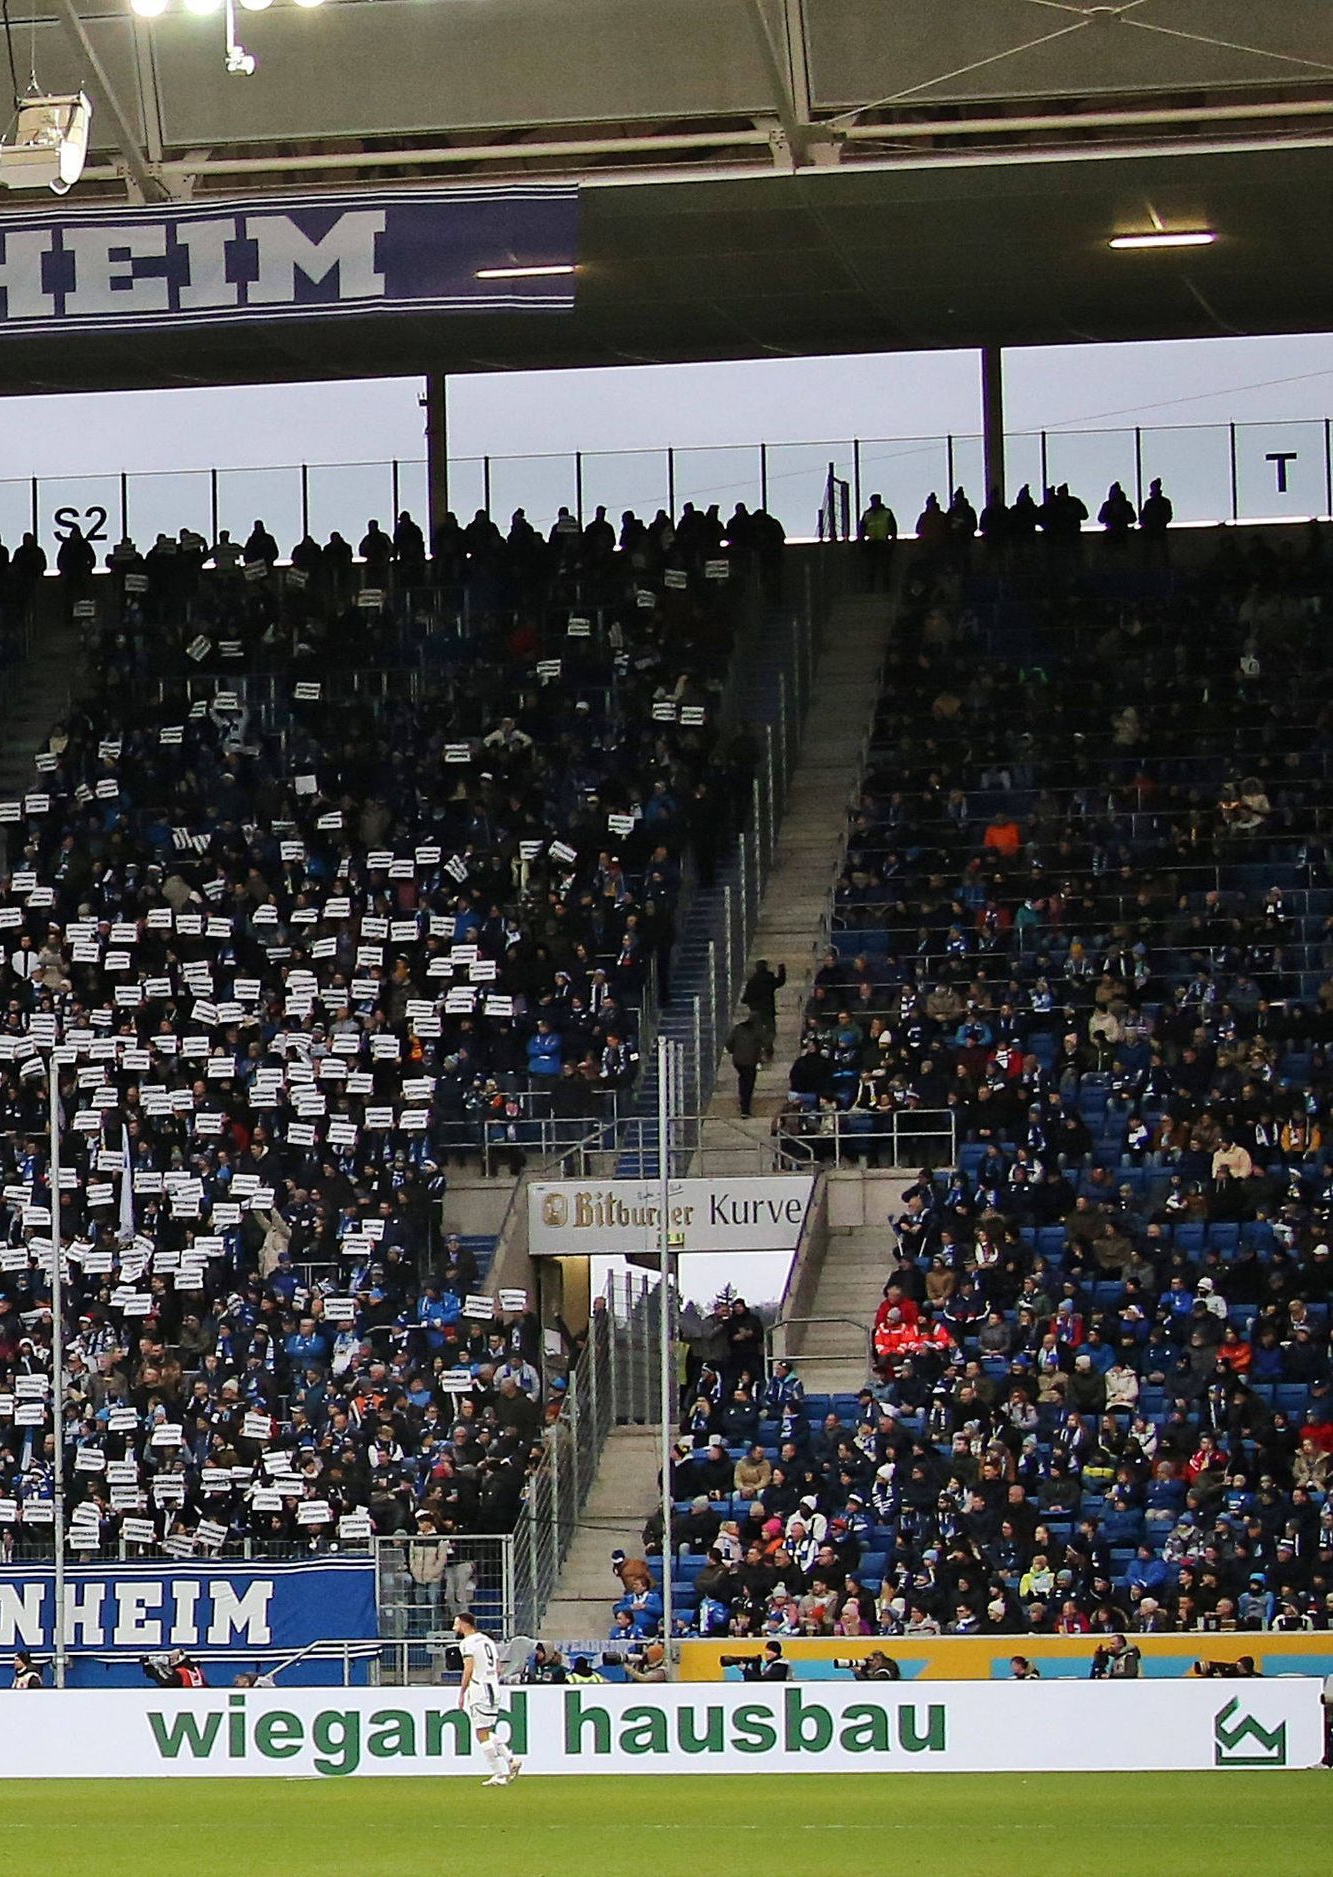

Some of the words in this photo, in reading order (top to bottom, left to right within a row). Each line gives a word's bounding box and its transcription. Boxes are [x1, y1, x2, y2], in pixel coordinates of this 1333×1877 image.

[1265, 452, 1297, 493] T
[54, 506, 108, 542] S2
[709, 1192, 803, 1226] Kurve
[484, 1643, 495, 1667] 9
[563, 1690, 948, 1755] hausbau
